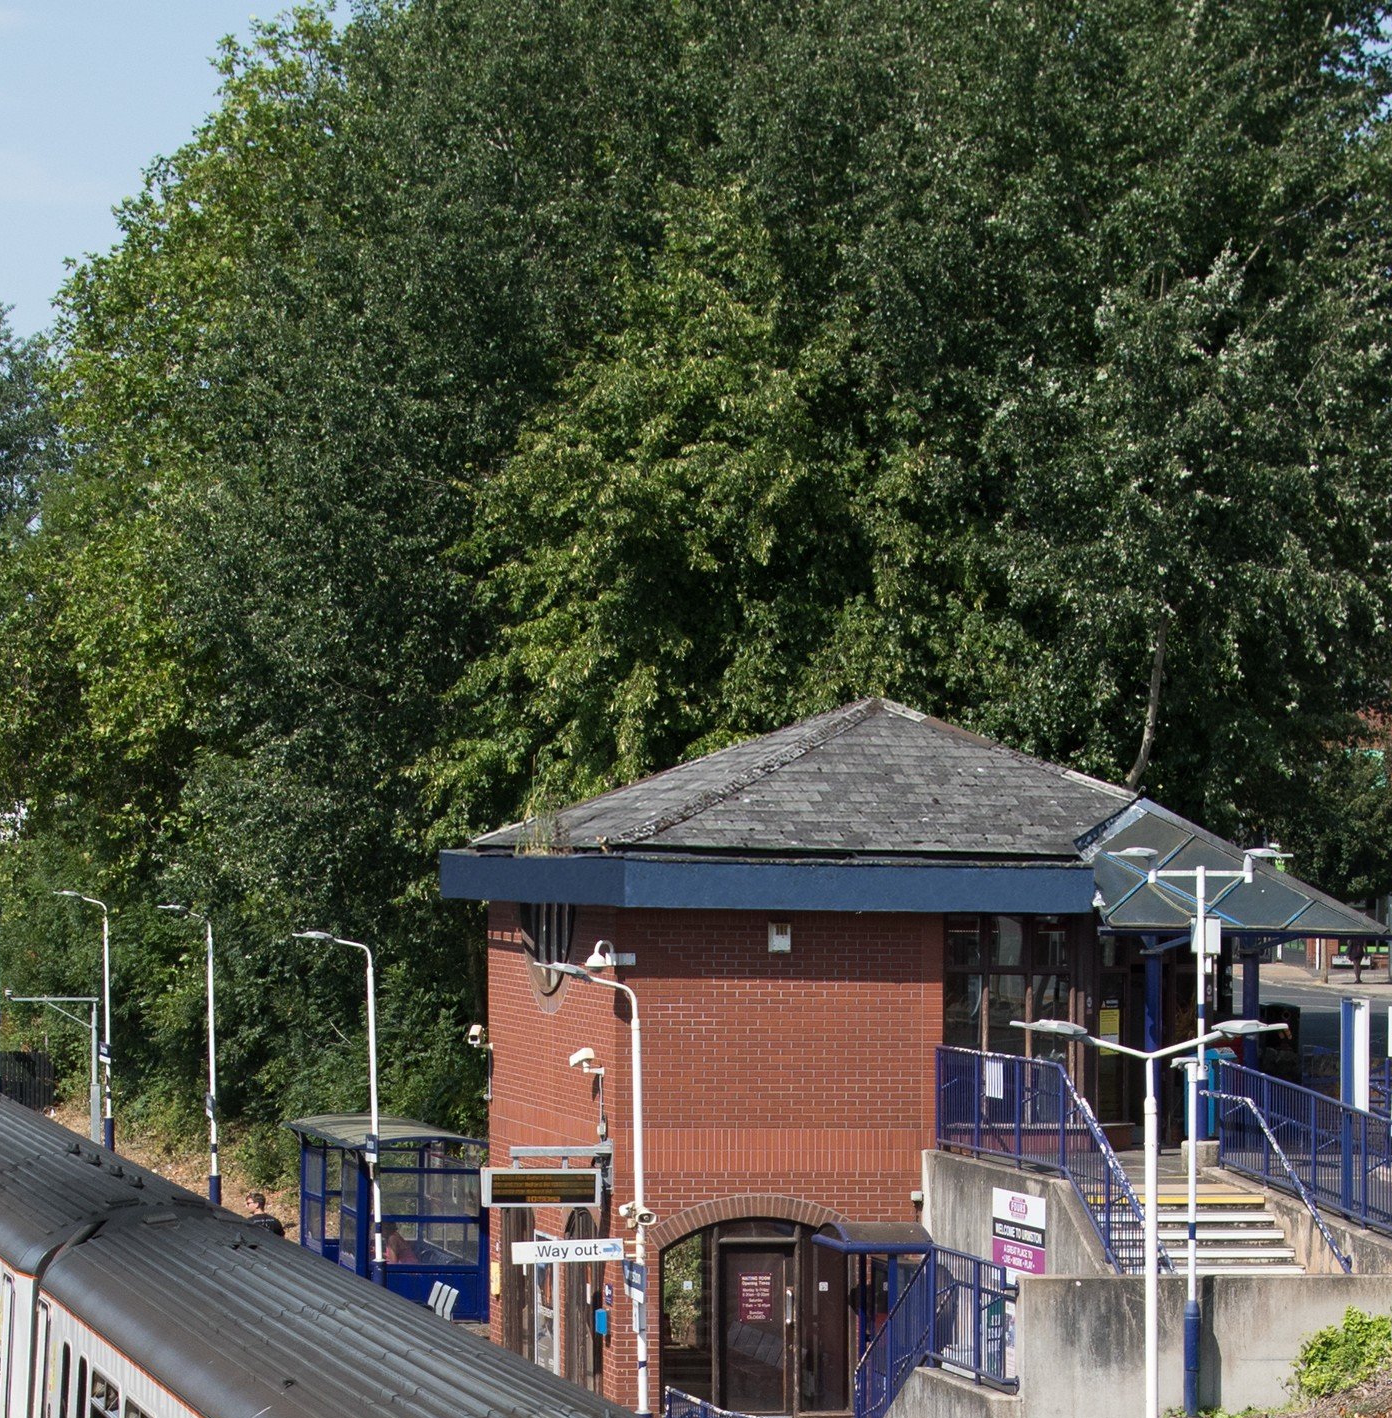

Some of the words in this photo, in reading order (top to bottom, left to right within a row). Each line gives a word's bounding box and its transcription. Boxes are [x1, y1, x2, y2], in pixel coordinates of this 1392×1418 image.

[995, 1222, 1016, 1237] WELCOME
[1016, 1227, 1022, 1239] TO
[1021, 1229, 1043, 1245] URMSTON
[537, 1245, 569, 1259] Way
[574, 1243, 599, 1256] out
